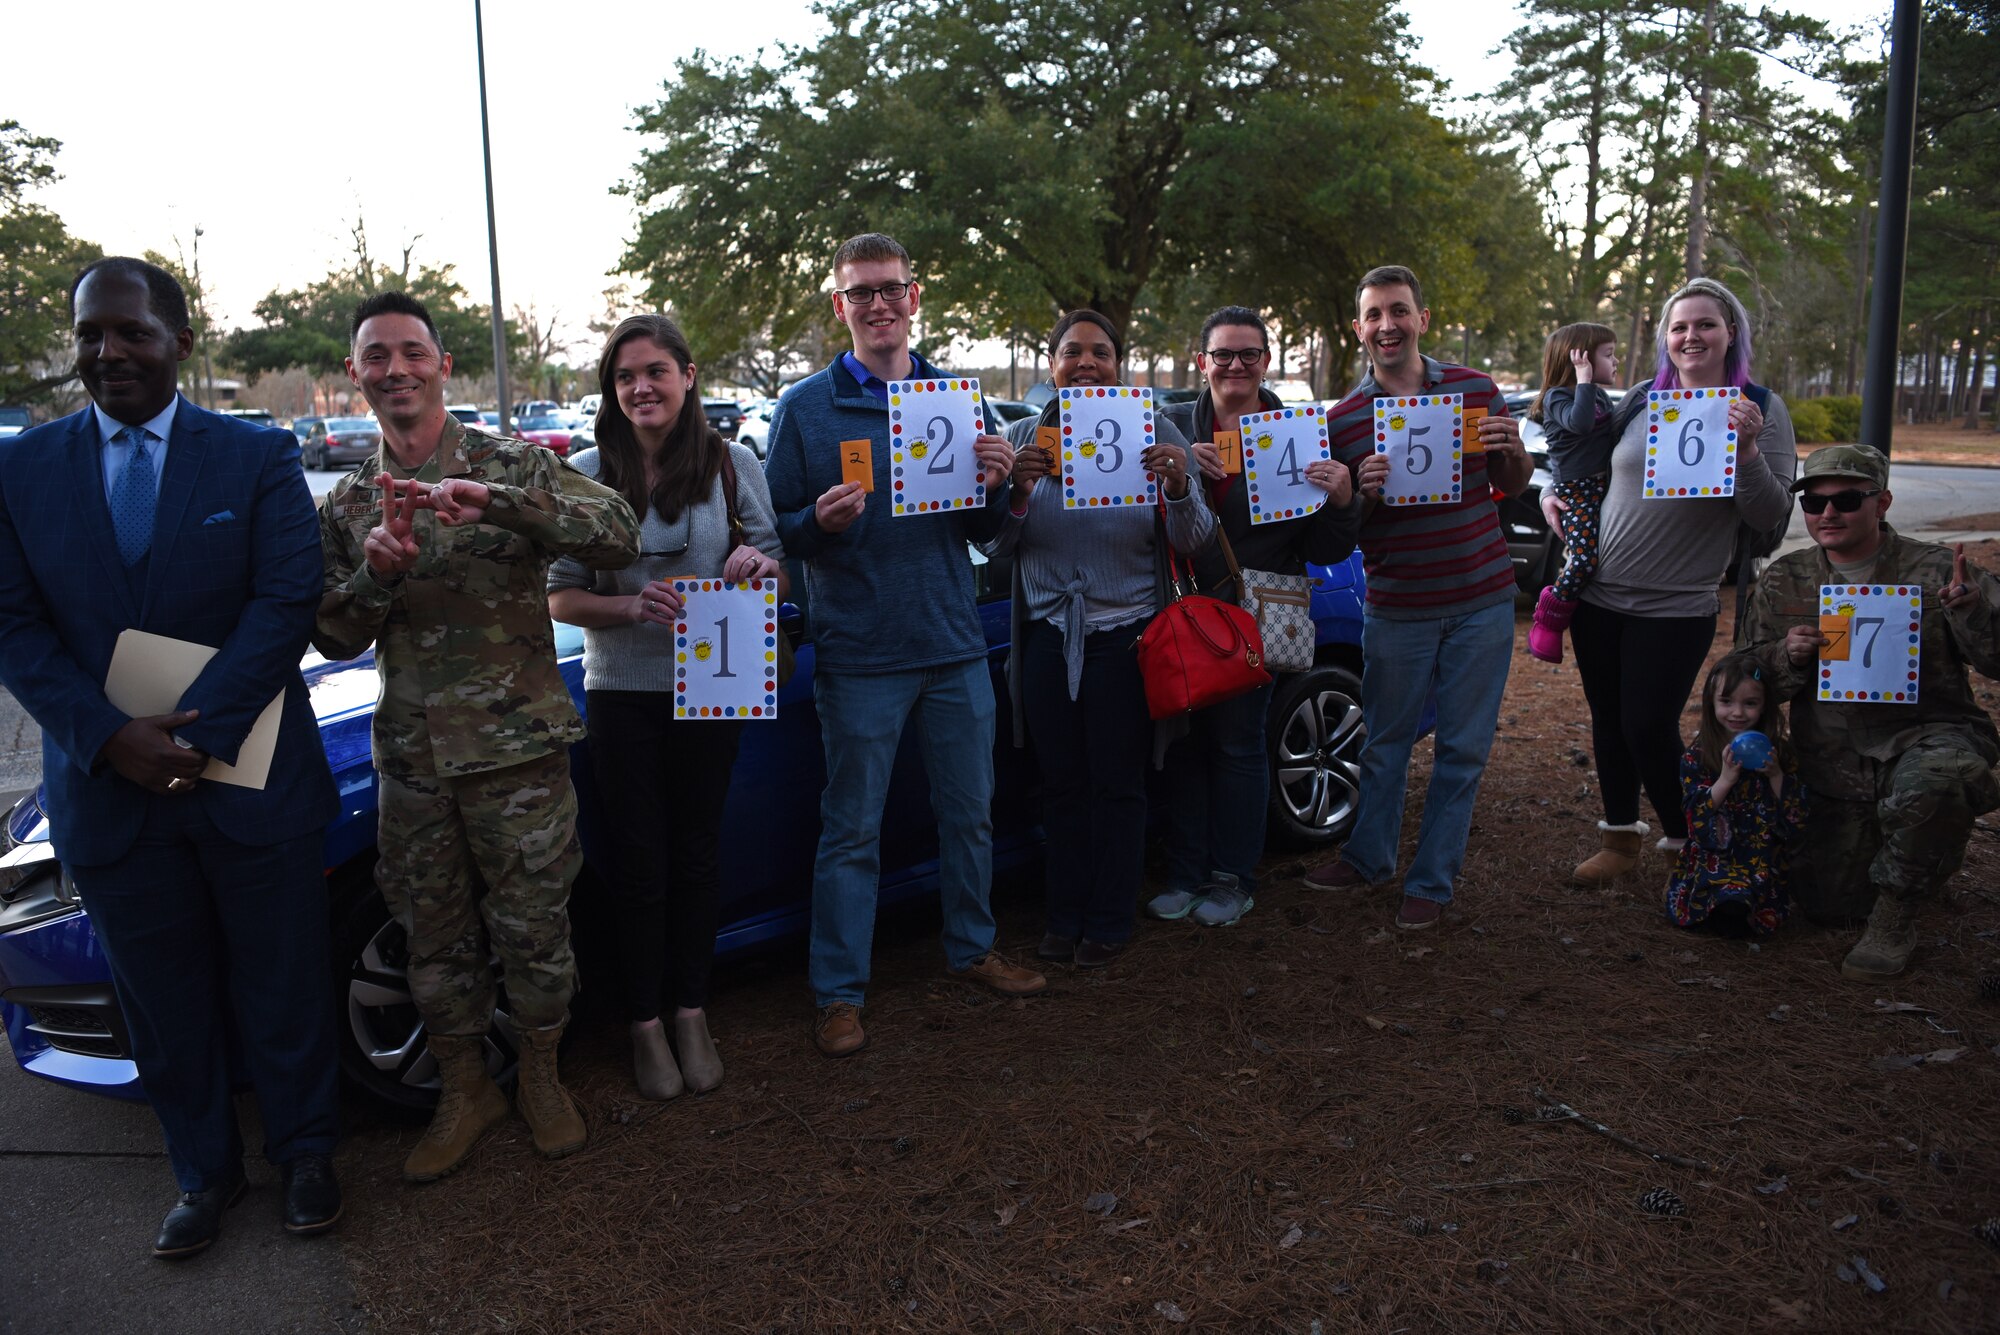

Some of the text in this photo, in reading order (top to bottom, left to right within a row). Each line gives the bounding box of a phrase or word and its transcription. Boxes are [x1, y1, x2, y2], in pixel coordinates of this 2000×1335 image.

[926, 415, 954, 475] 2
[1095, 418, 1123, 473] 3
[1219, 437, 1233, 465] 4
[1406, 425, 1433, 475] 5
[1466, 416, 1482, 442] 5
[1678, 418, 1705, 467] 6
[849, 452, 865, 464] 2
[1276, 437, 1304, 487] 4
[343, 504, 376, 515] HEBERT
[713, 616, 737, 678] 1
[1824, 630, 1847, 653] 7
[1855, 617, 1885, 669] 7
